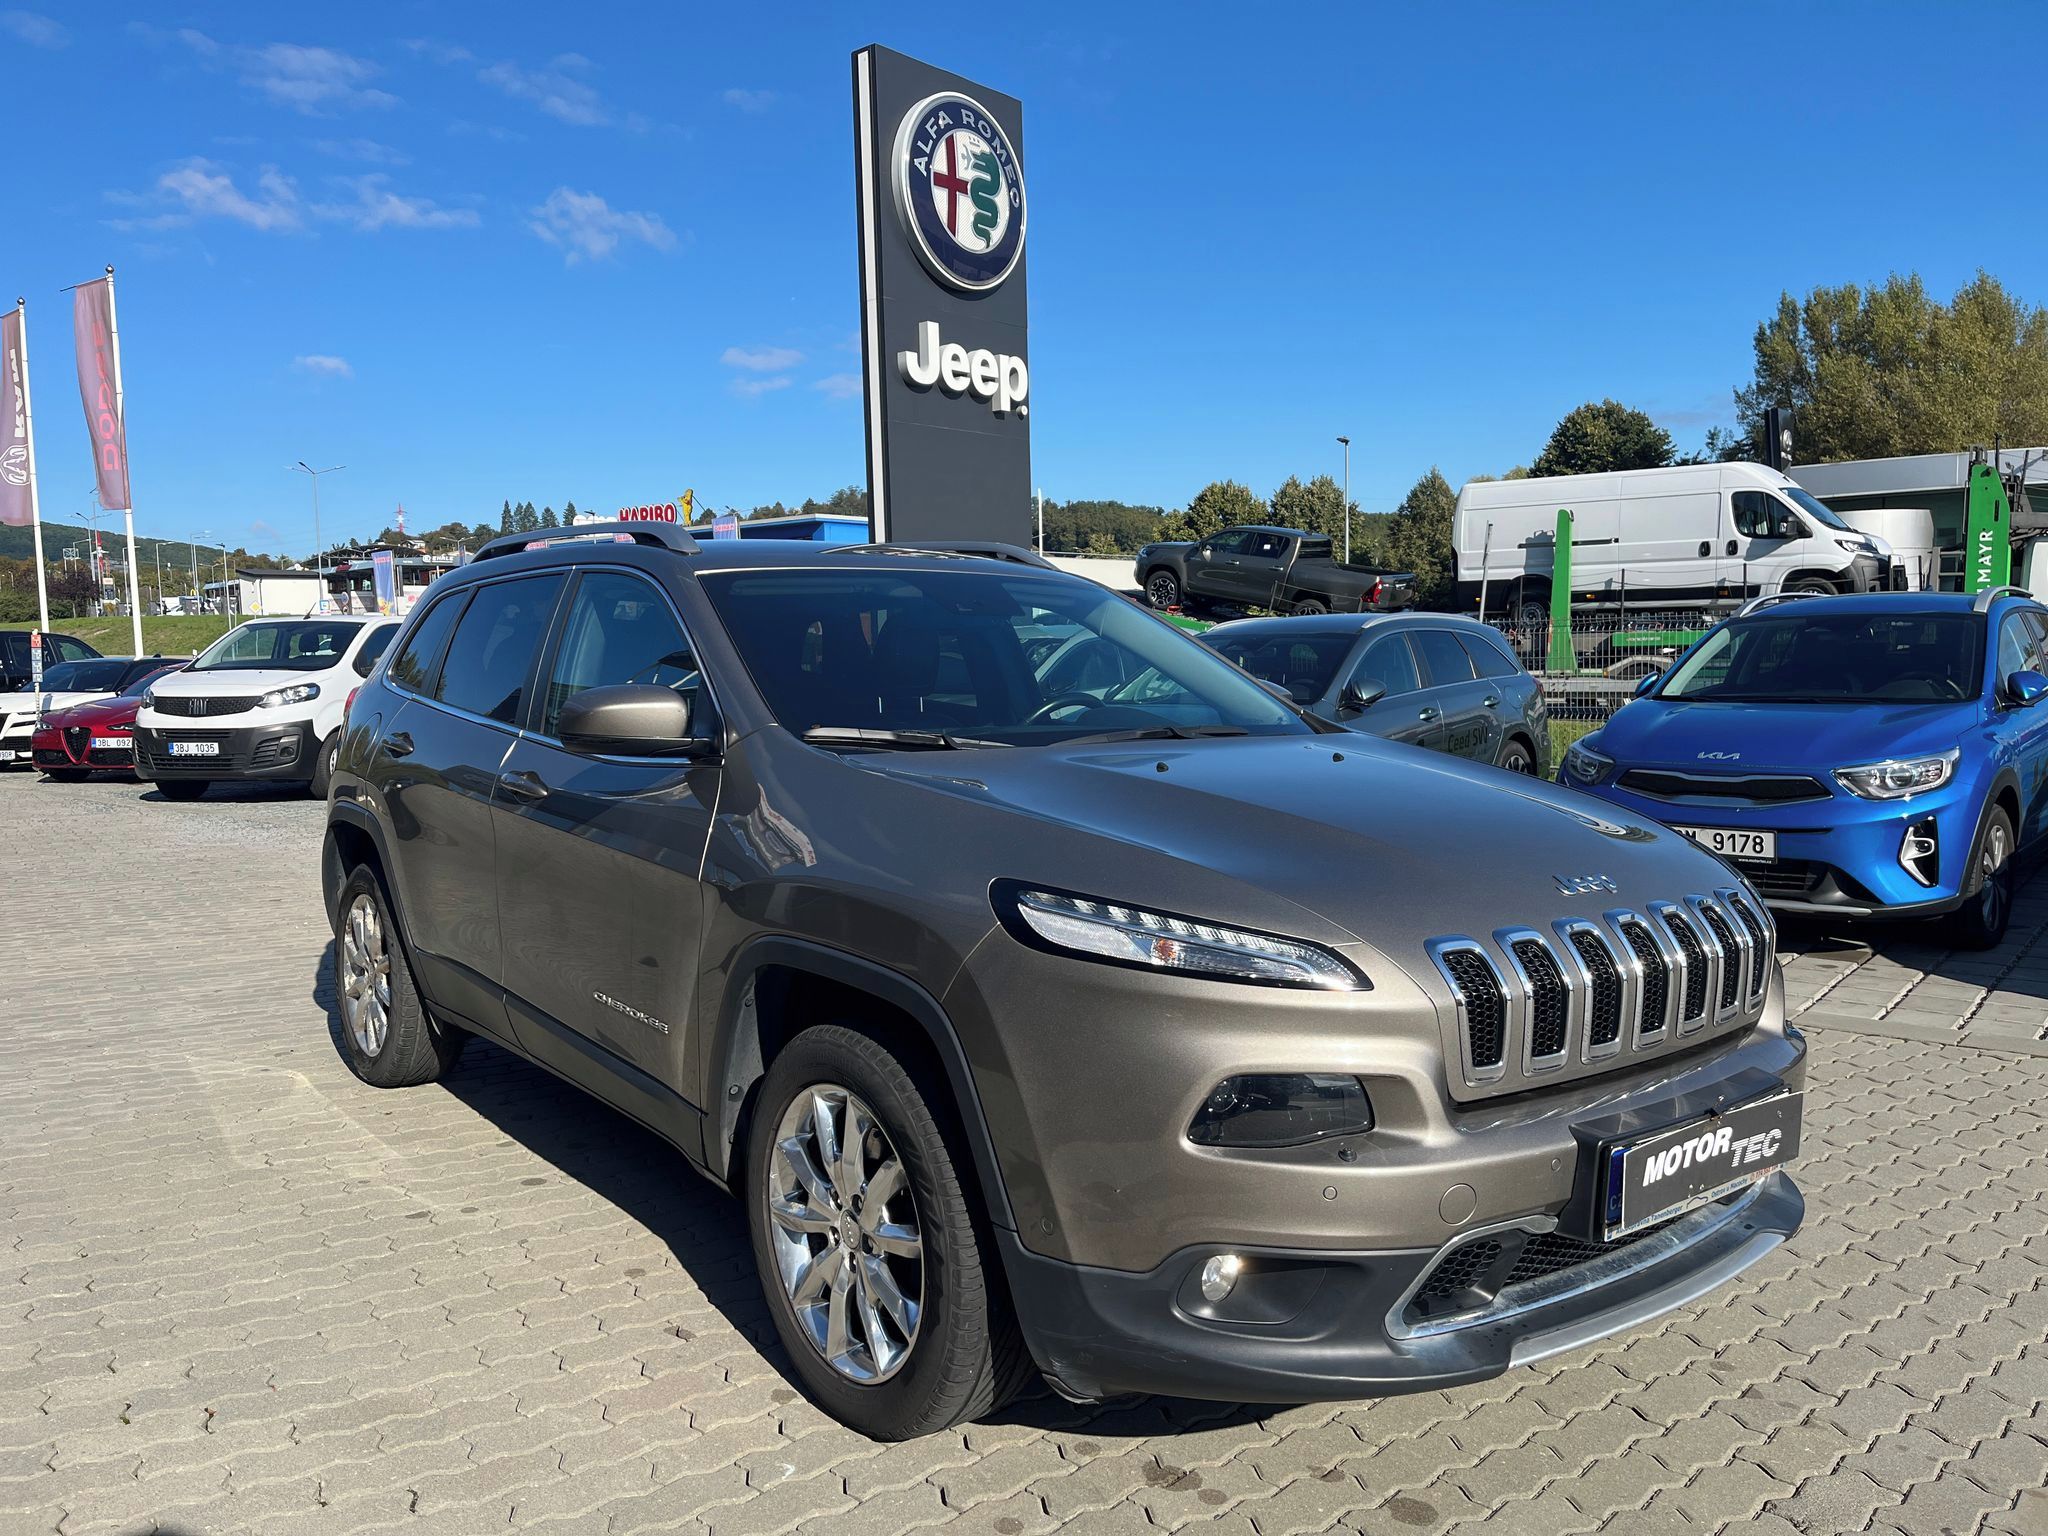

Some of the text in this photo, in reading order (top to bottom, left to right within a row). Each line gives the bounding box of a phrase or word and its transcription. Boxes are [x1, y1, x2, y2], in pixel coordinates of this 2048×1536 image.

[913, 109, 1021, 209] ALFA ROMEO
[898, 320, 1028, 412] Jeep
[97, 738, 111, 747] 3BL
[175, 743, 215, 753] 3BJ 1035
[1447, 728, 1471, 753] Ceed
[1472, 726, 1488, 746] SW
[1713, 832, 1765, 854] 9178
[1552, 873, 1618, 897] Jeep
[593, 991, 669, 1034] CHEROKEE
[1642, 1126, 1782, 1187] MOTOR TEC
